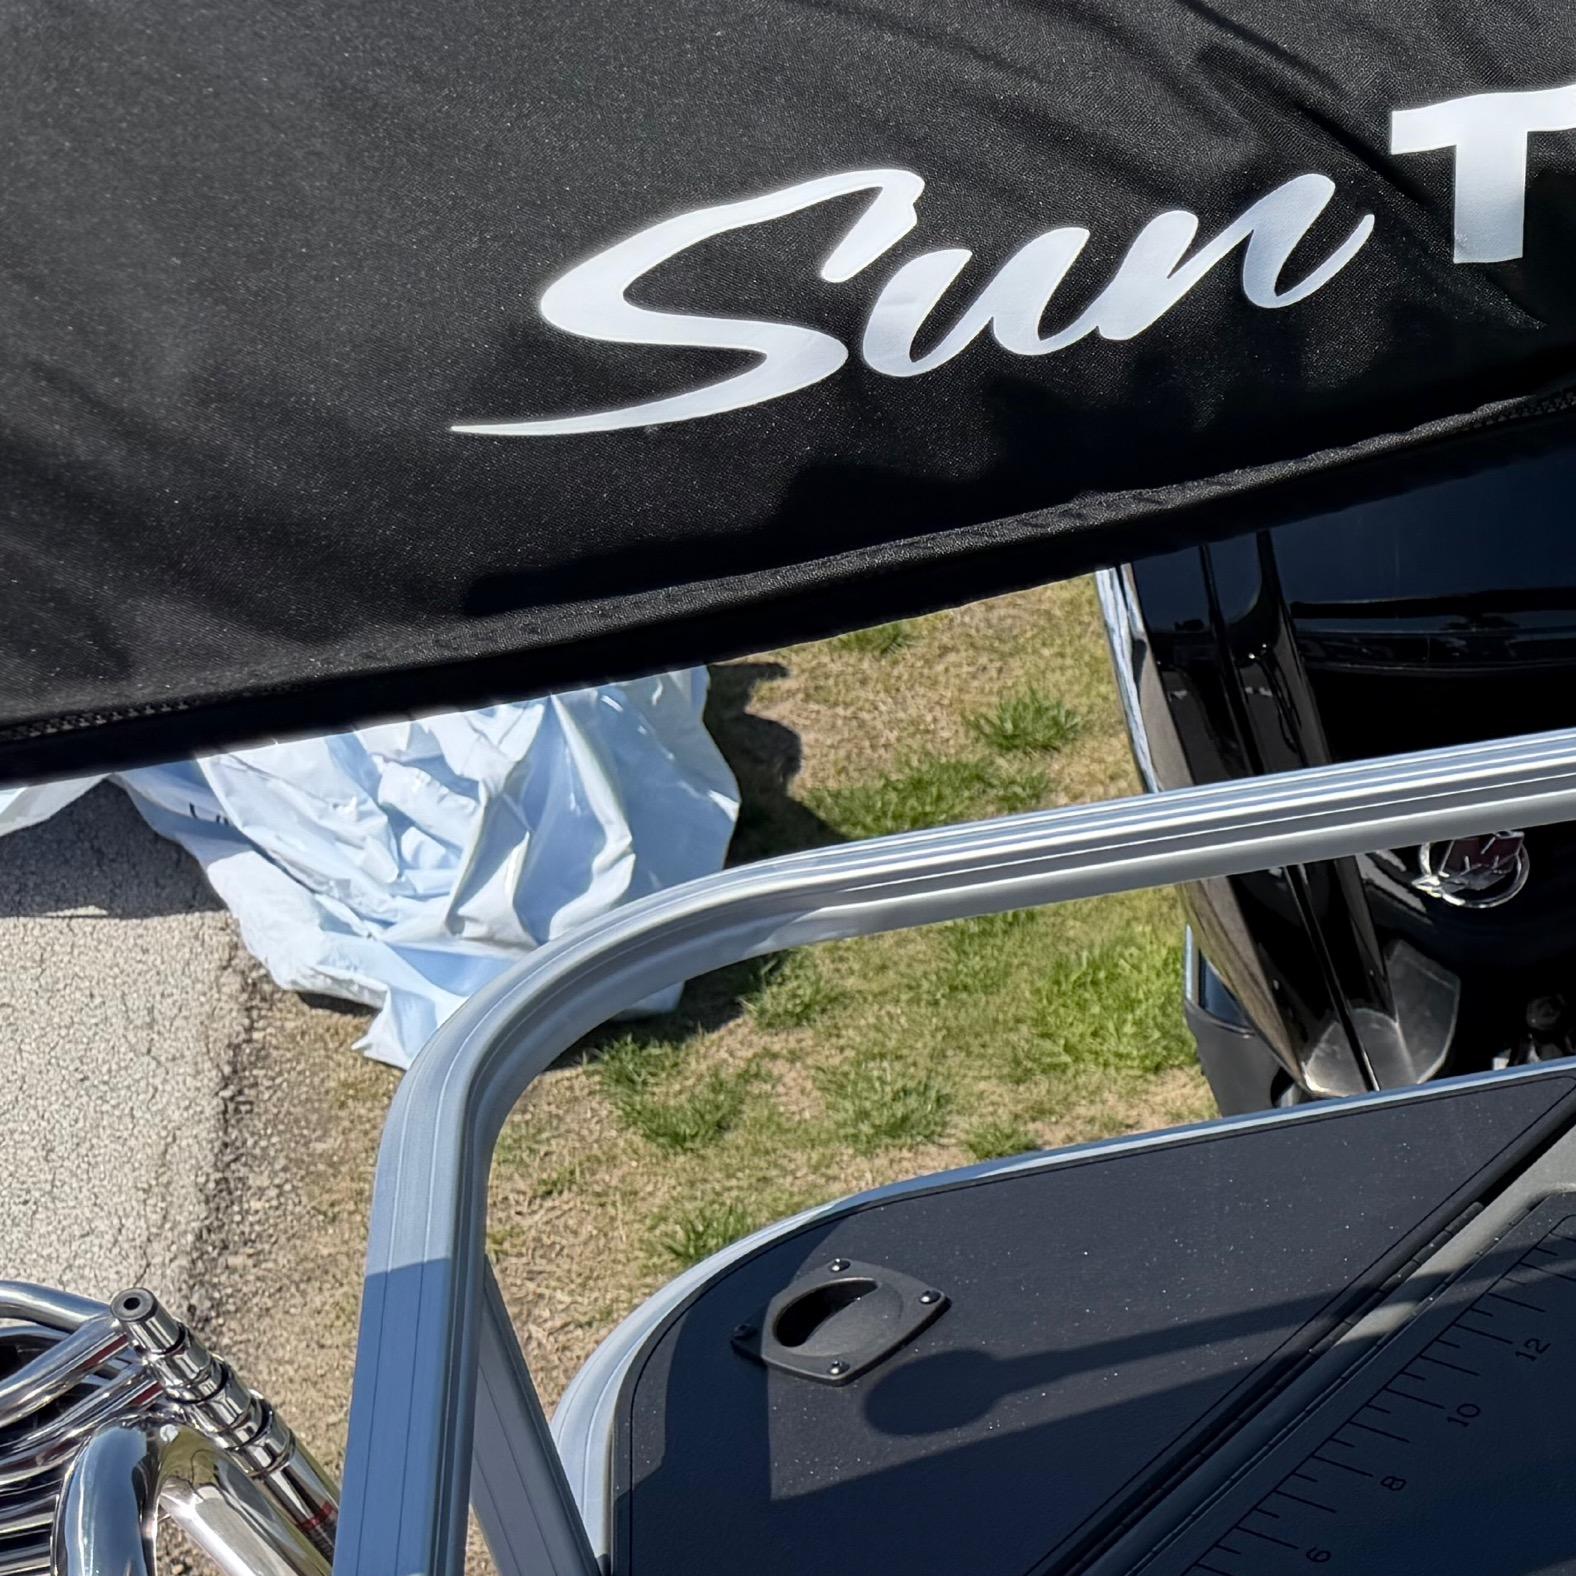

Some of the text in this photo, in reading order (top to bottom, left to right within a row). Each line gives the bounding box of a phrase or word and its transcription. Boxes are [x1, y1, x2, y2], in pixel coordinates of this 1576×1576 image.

[450, 168, 1374, 436] Sun
[1305, 1547, 1331, 1563] 6
[1380, 1476, 1407, 1492] 8
[1447, 1403, 1481, 1427] 10
[1515, 1337, 1552, 1362] 12
